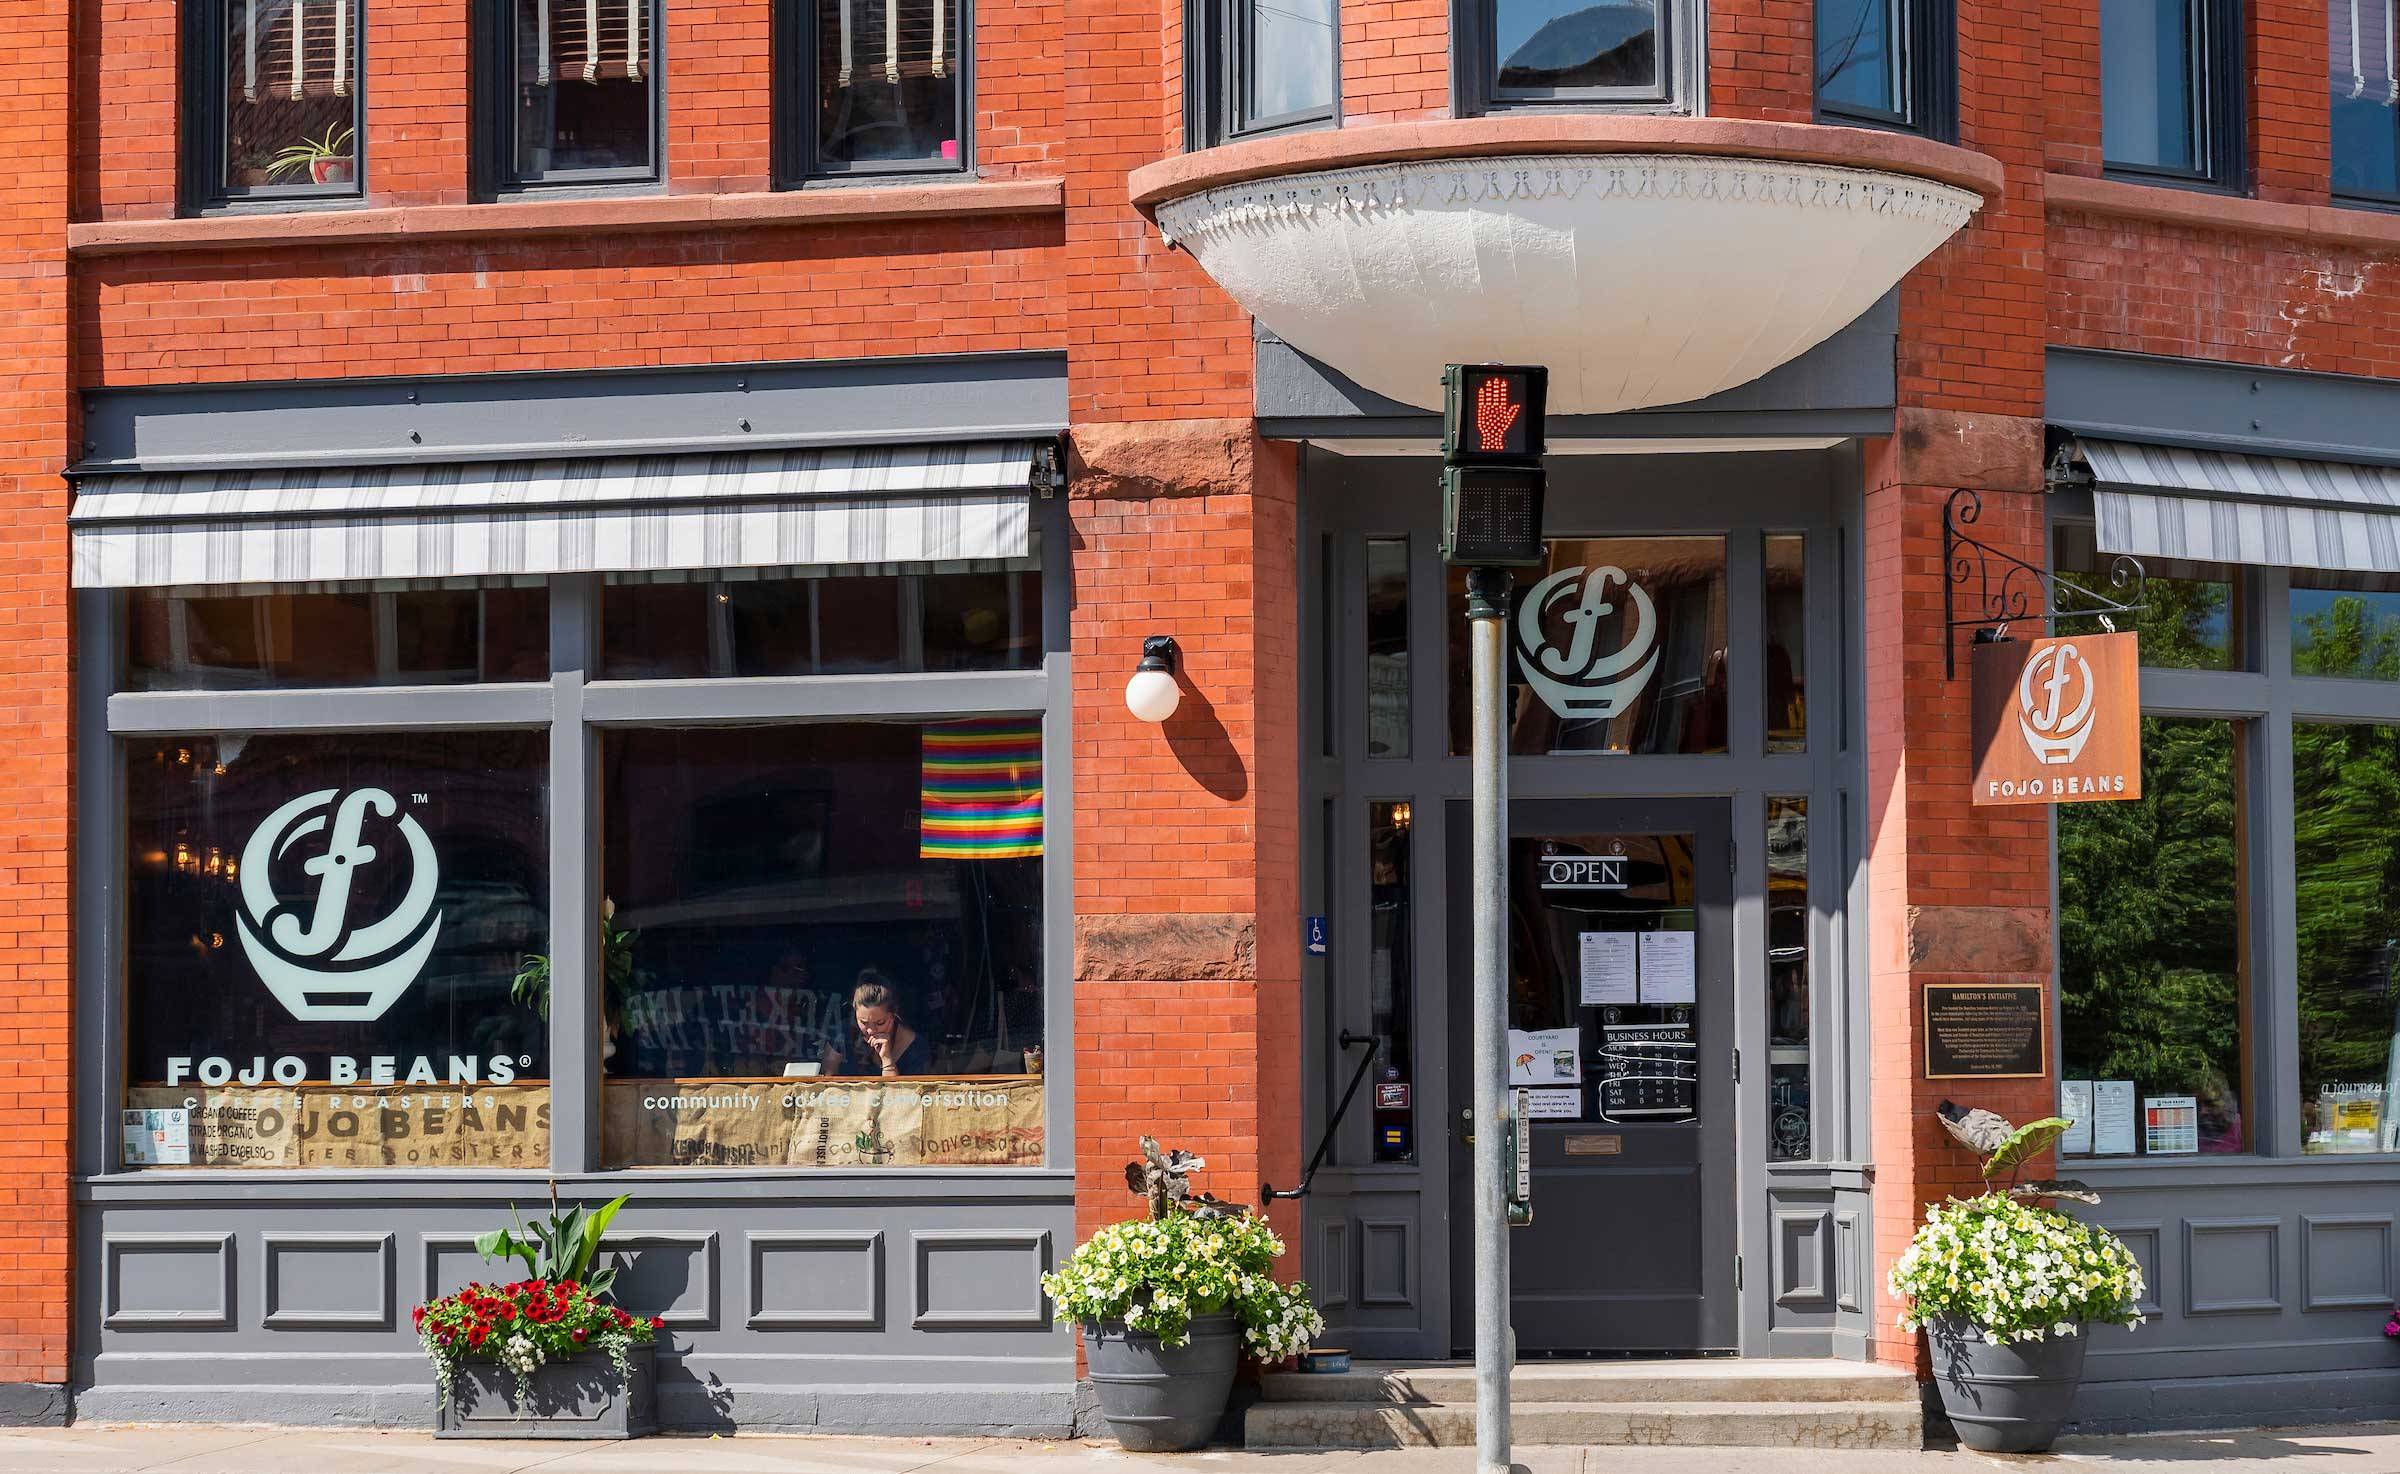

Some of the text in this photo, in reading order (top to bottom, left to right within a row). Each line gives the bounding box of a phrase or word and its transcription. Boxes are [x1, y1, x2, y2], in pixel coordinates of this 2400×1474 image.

[1988, 775, 2125, 797] FOJO BEANS
[1549, 861, 1620, 884] OPEN
[1988, 992, 2017, 1000] INITIATIVE
[1607, 1031, 1686, 1041] BUSINESS HOURS
[167, 1056, 307, 1087] FOJO
[2321, 1083, 2329, 1095] a
[2330, 1079, 2383, 1098] journey
[183, 1095, 495, 1110] COFFEE ROASTERS
[643, 1090, 1009, 1112] community coffee conversation
[191, 1106, 257, 1121] ORGANIC COFFEE
[821, 1118, 829, 1128] DO
[188, 1125, 253, 1140] RTRADE ORGANIC
[820, 1130, 829, 1145] NOT
[198, 1144, 229, 1157] WASHED
[231, 1144, 266, 1159] EXCELSO
